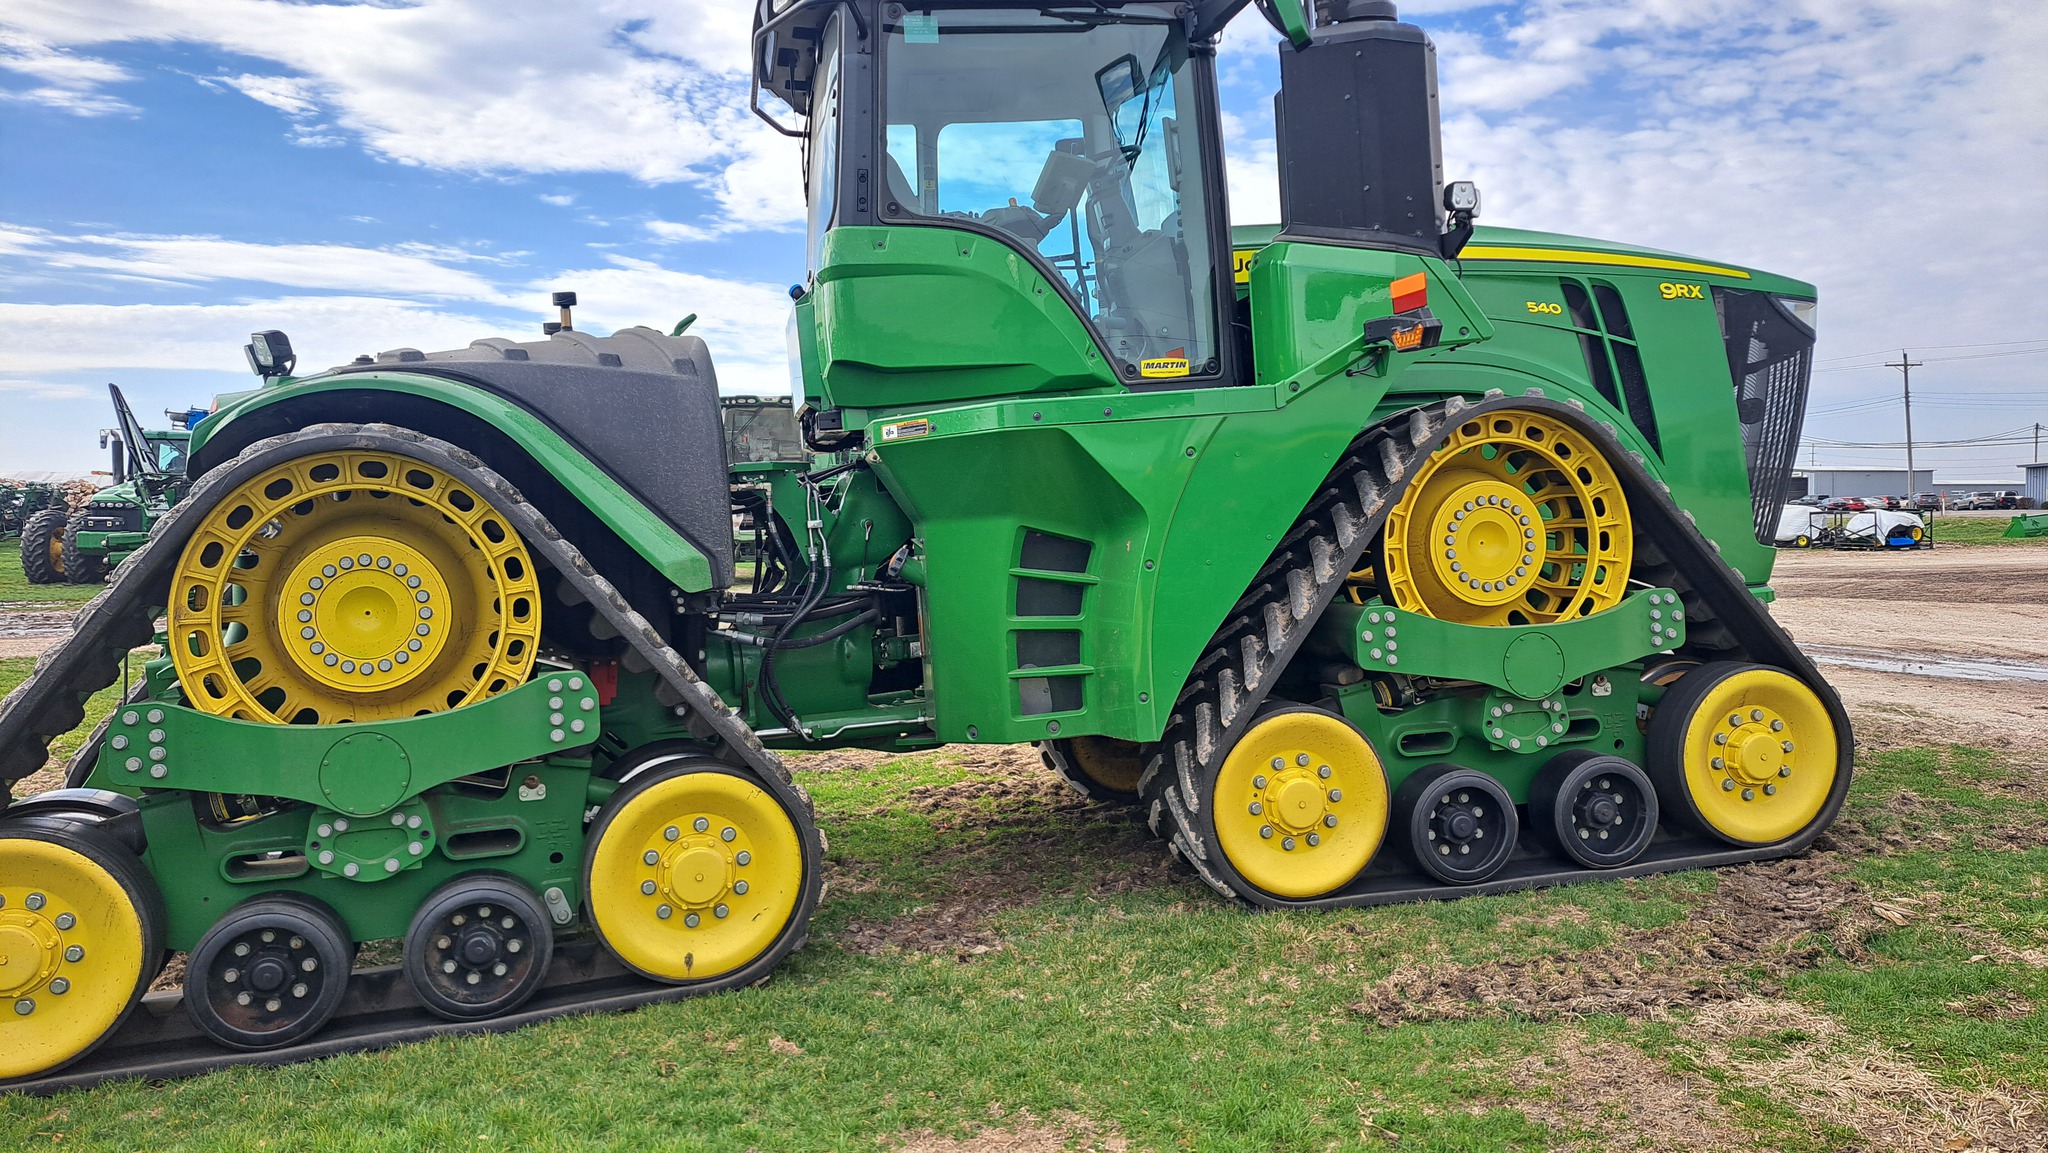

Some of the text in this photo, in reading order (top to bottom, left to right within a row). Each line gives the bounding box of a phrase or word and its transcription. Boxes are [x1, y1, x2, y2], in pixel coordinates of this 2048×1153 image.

[1659, 282, 1705, 300] 9RX
[1526, 301, 1563, 315] 540
[1144, 361, 1187, 370] MARTIN
